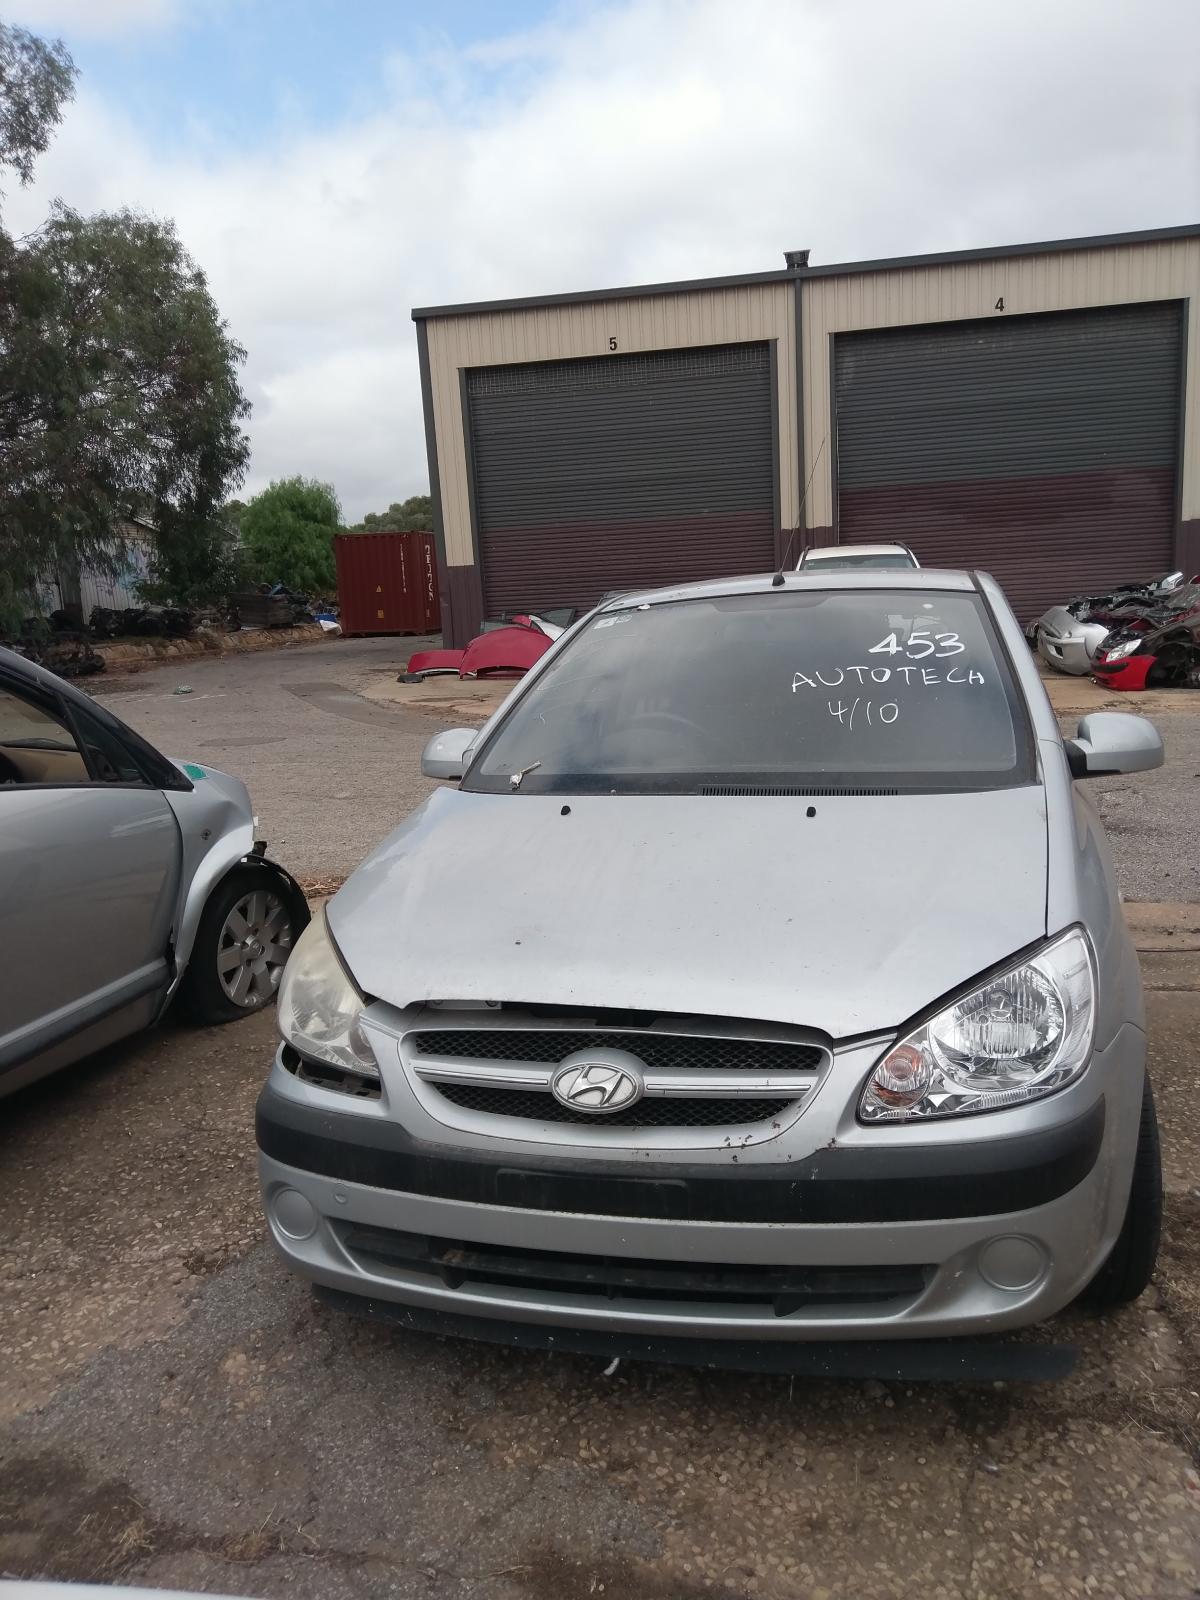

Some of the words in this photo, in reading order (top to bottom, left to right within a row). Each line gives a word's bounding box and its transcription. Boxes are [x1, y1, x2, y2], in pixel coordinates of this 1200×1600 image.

[994, 296, 1005, 312] 4
[609, 336, 618, 351] 5
[868, 631, 966, 659] 453
[791, 666, 985, 693] AUTOTECH
[828, 697, 899, 731] 4/10
